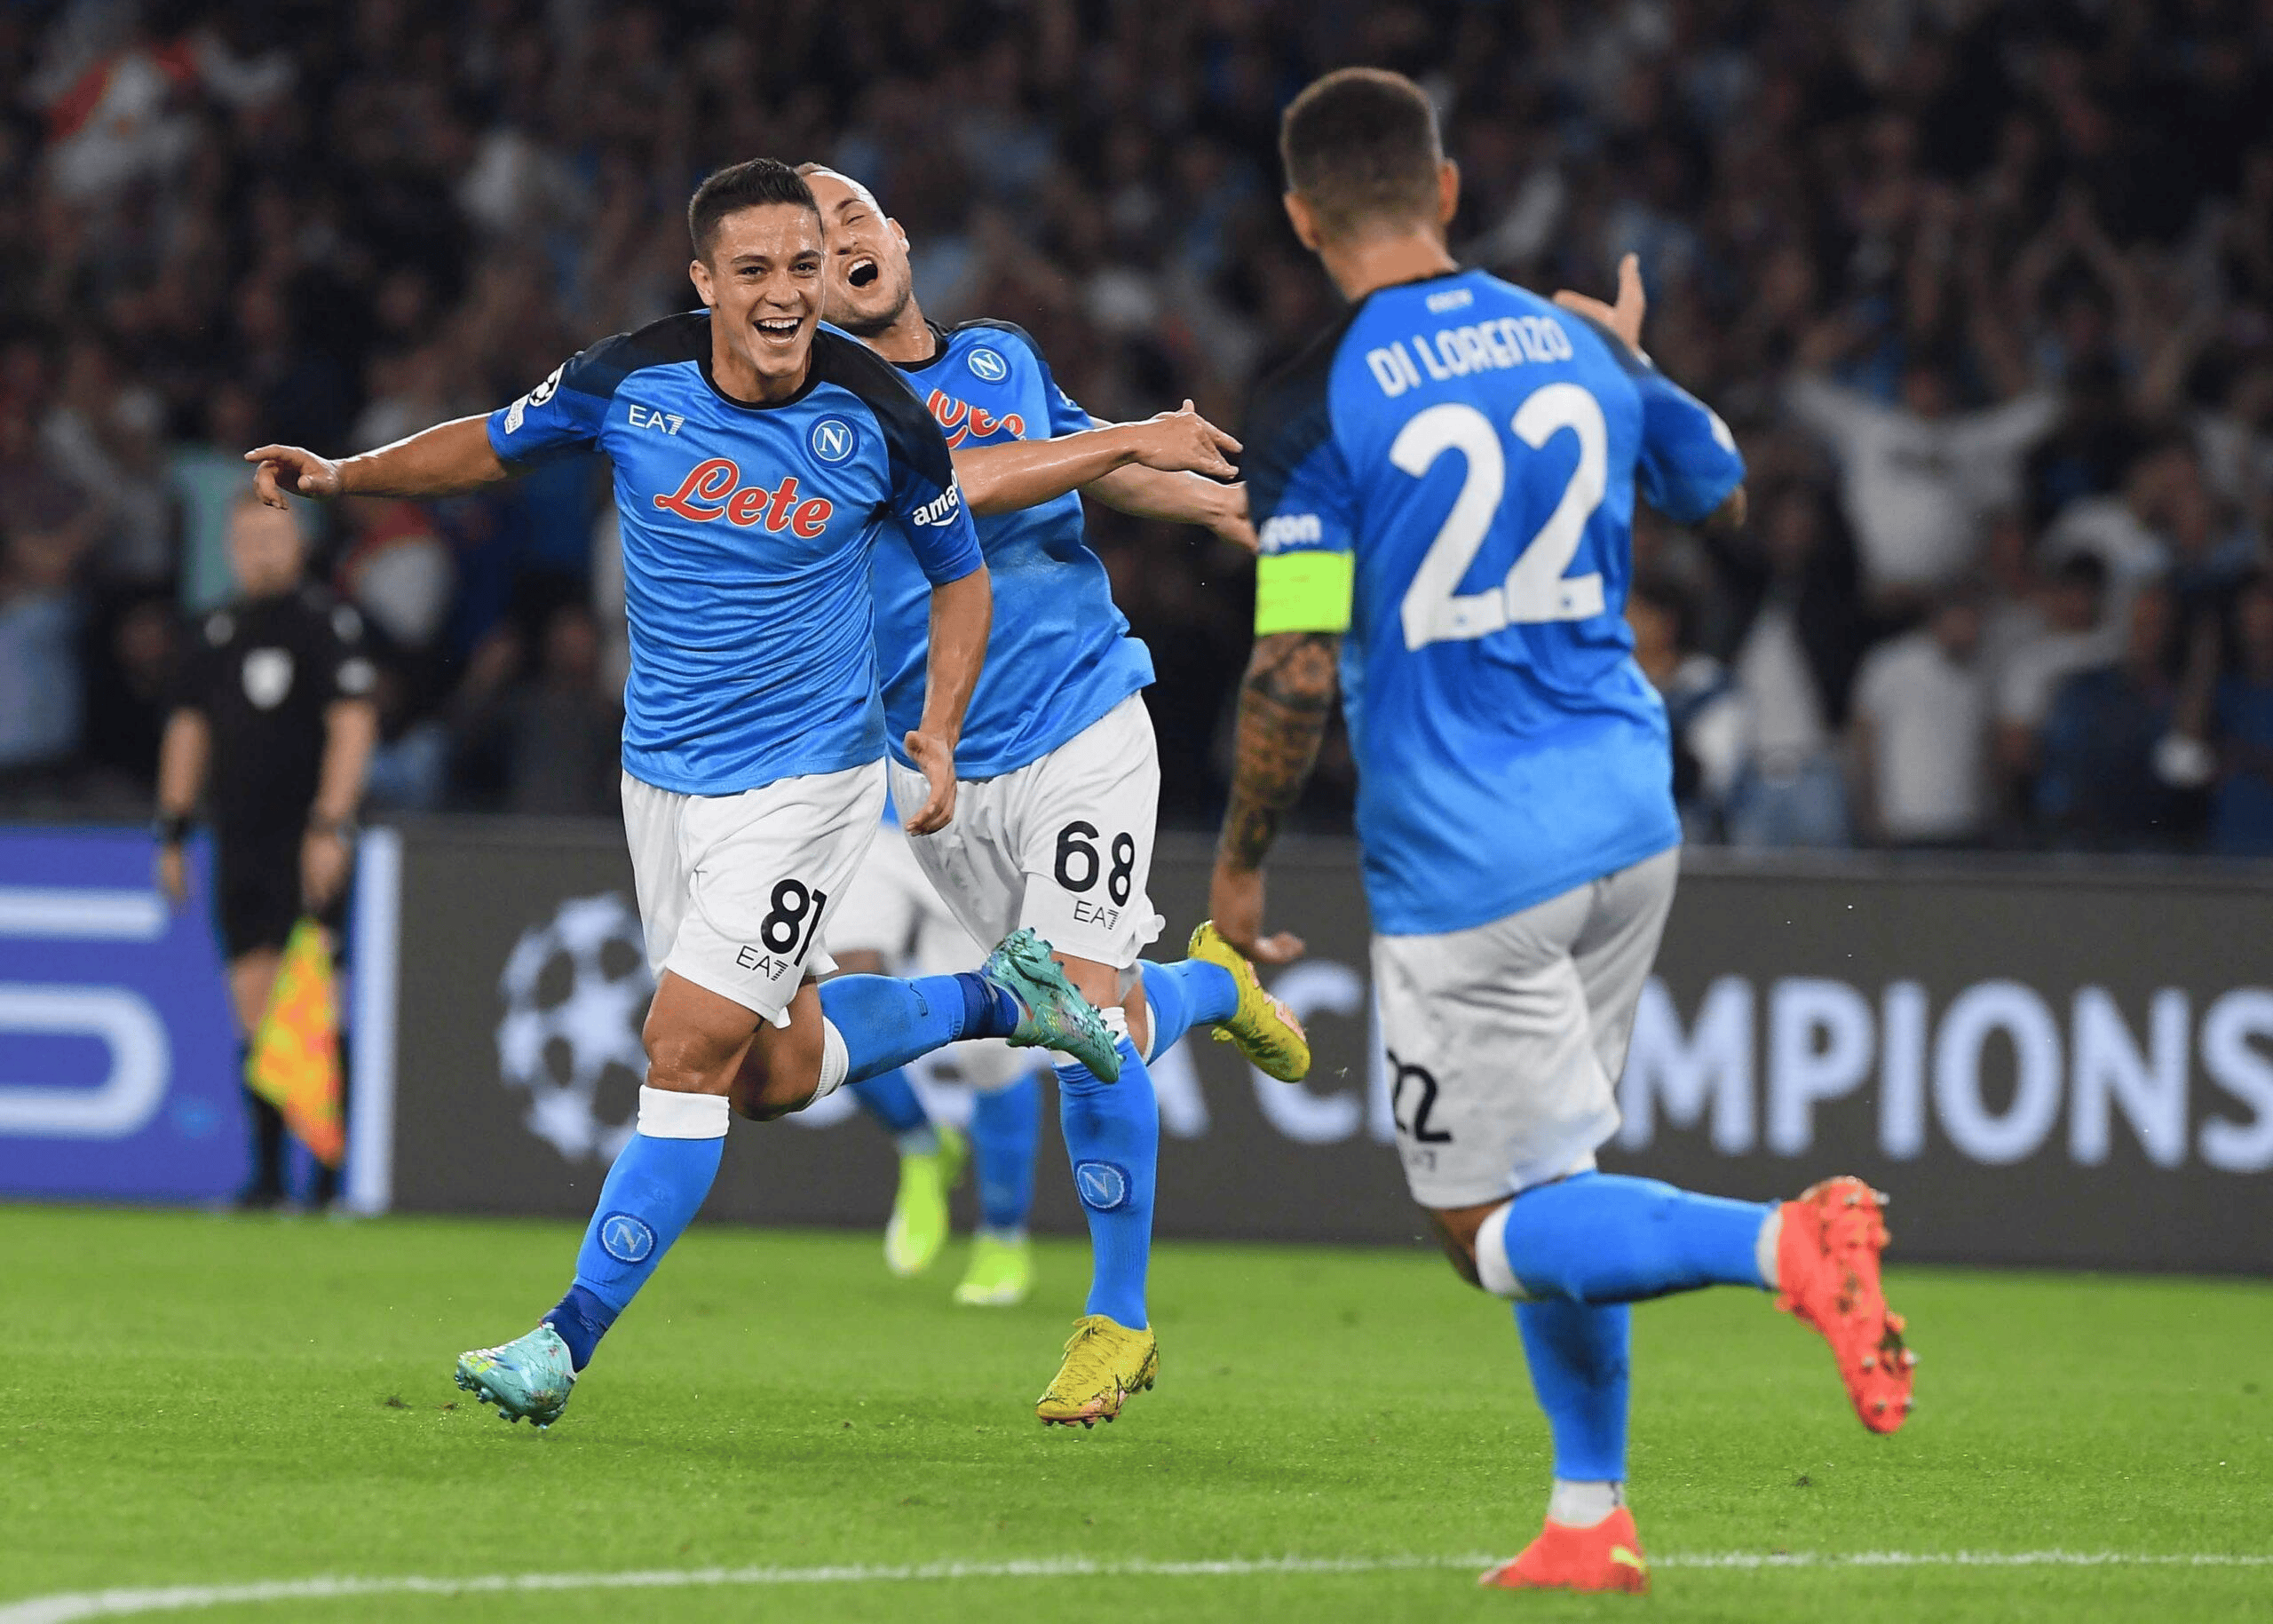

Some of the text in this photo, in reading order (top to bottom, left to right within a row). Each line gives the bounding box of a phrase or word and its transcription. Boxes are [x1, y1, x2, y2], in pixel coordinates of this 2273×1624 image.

[1366, 315, 1574, 399] DI LORENZO
[629, 404, 685, 435] EA7
[820, 426, 845, 455] N
[653, 457, 833, 538] Lete
[1389, 382, 1605, 654] 22
[1054, 820, 1135, 907] 68
[761, 879, 828, 967] 81
[1073, 899, 1119, 930] EA7
[736, 945, 788, 982] EA7
[1250, 961, 2273, 1174] CMPIONS
